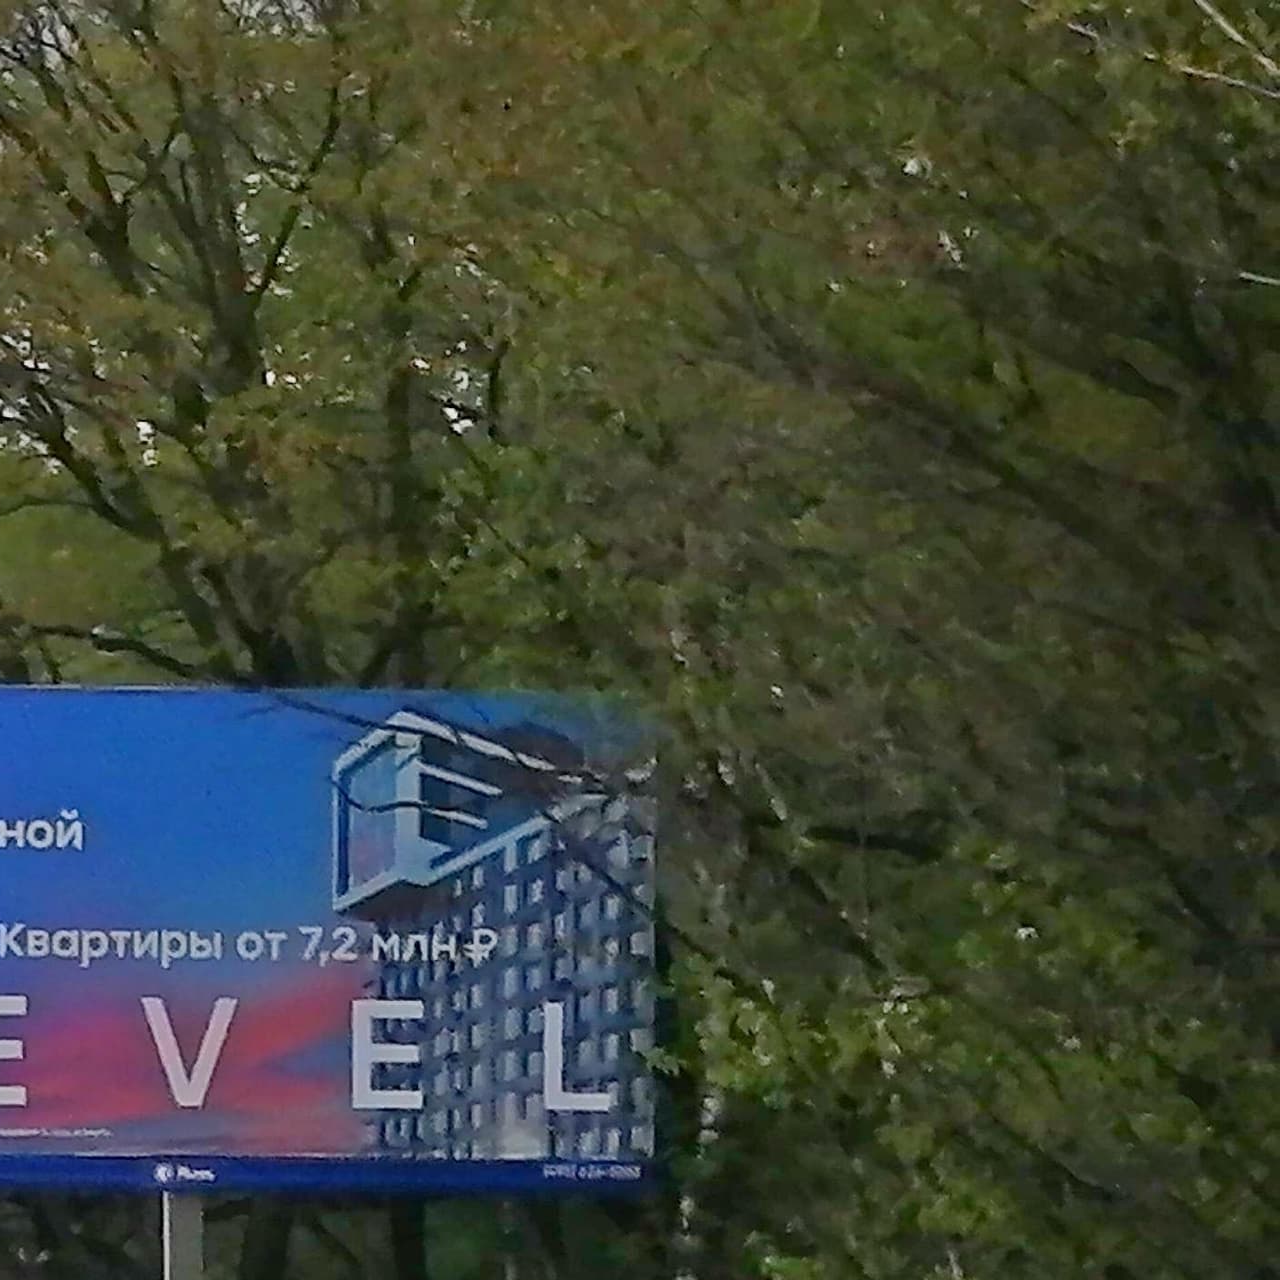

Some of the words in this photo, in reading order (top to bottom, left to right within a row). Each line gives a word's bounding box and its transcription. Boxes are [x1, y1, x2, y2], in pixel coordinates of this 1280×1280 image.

[238, 930, 289, 961] от
[297, 925, 358, 967] 7,2
[372, 931, 458, 963] млн
